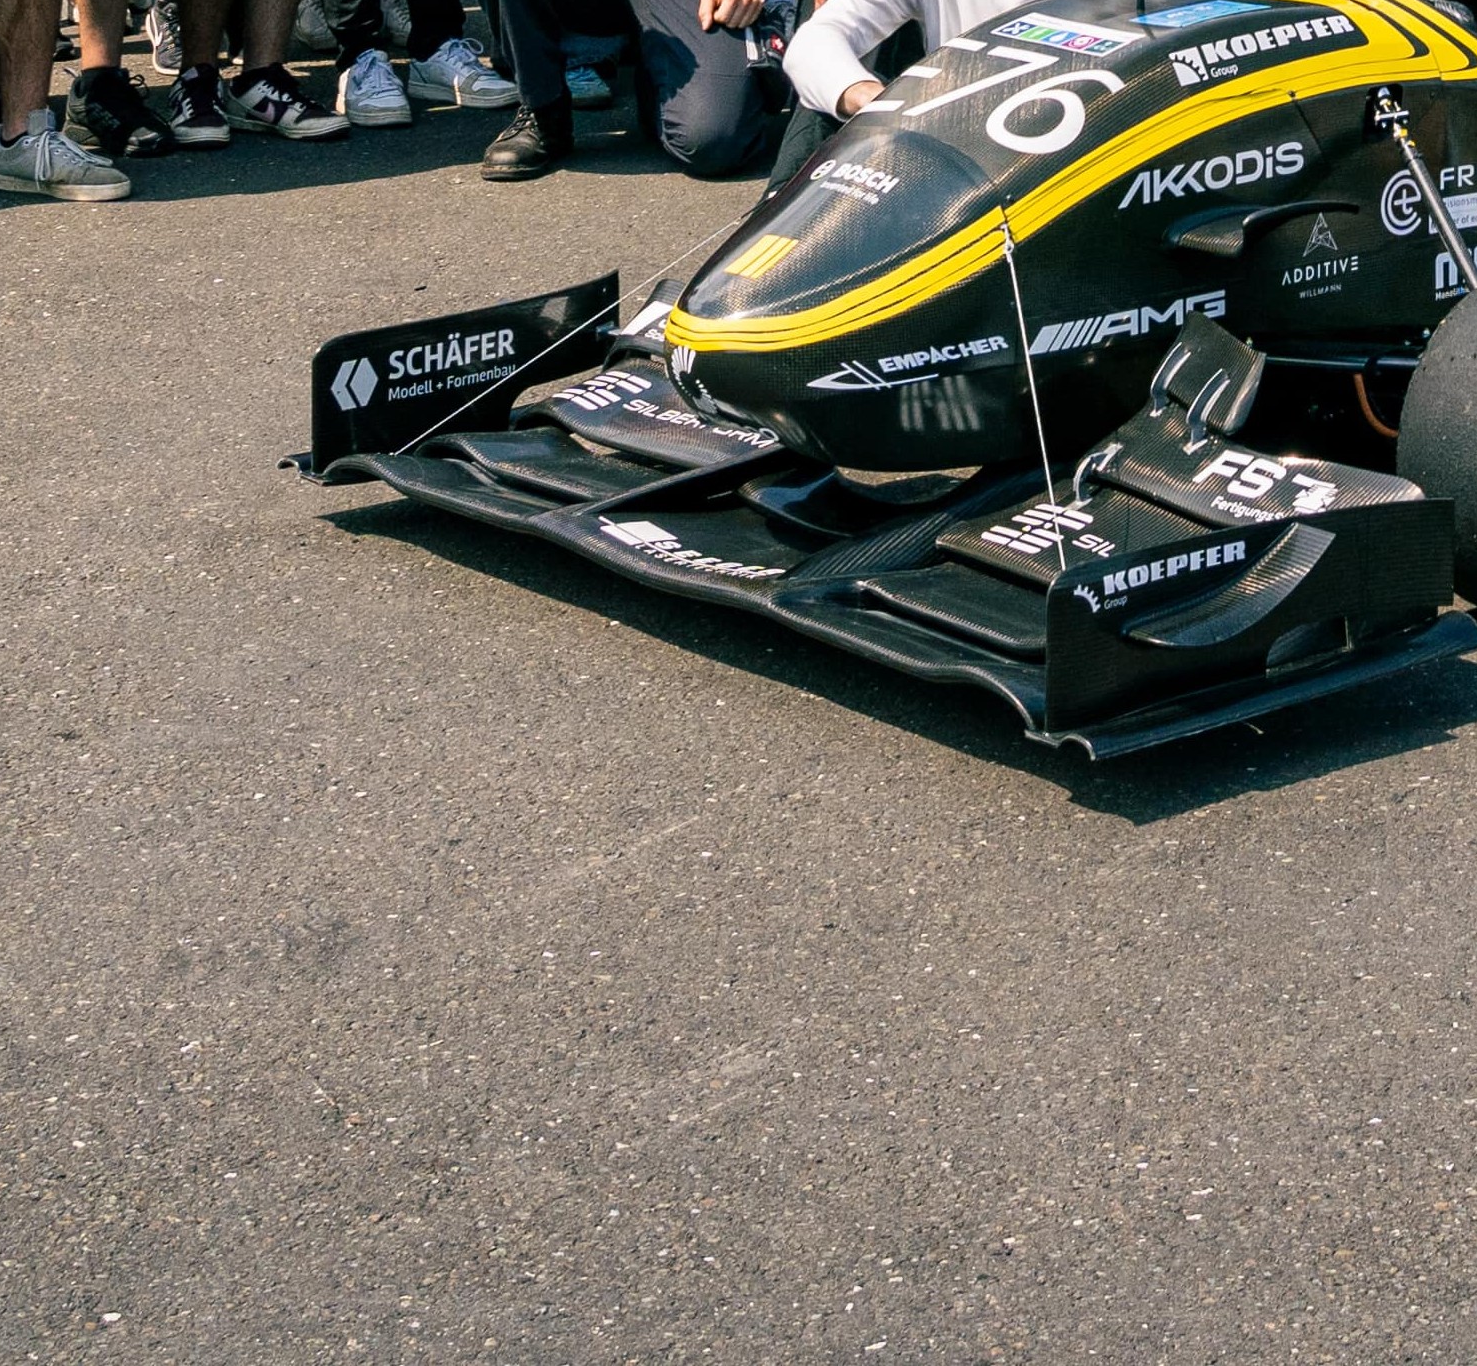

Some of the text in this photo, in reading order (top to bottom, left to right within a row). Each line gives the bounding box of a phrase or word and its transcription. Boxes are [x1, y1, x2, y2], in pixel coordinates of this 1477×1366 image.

[1200, 14, 1356, 64] KOEPFER
[1211, 63, 1239, 79] Group
[831, 163, 900, 194] BOSCH
[1282, 255, 1360, 287] ADDITIVE
[1299, 283, 1342, 299] WILLMANN
[1093, 290, 1226, 345] AMG
[387, 327, 515, 381] SCHÄFER
[878, 336, 1010, 373] EMPACHER
[387, 380, 427, 402] Modell
[444, 363, 516, 392] Formenbau
[1103, 540, 1246, 595] KOEPFER
[1104, 595, 1128, 609] Group
